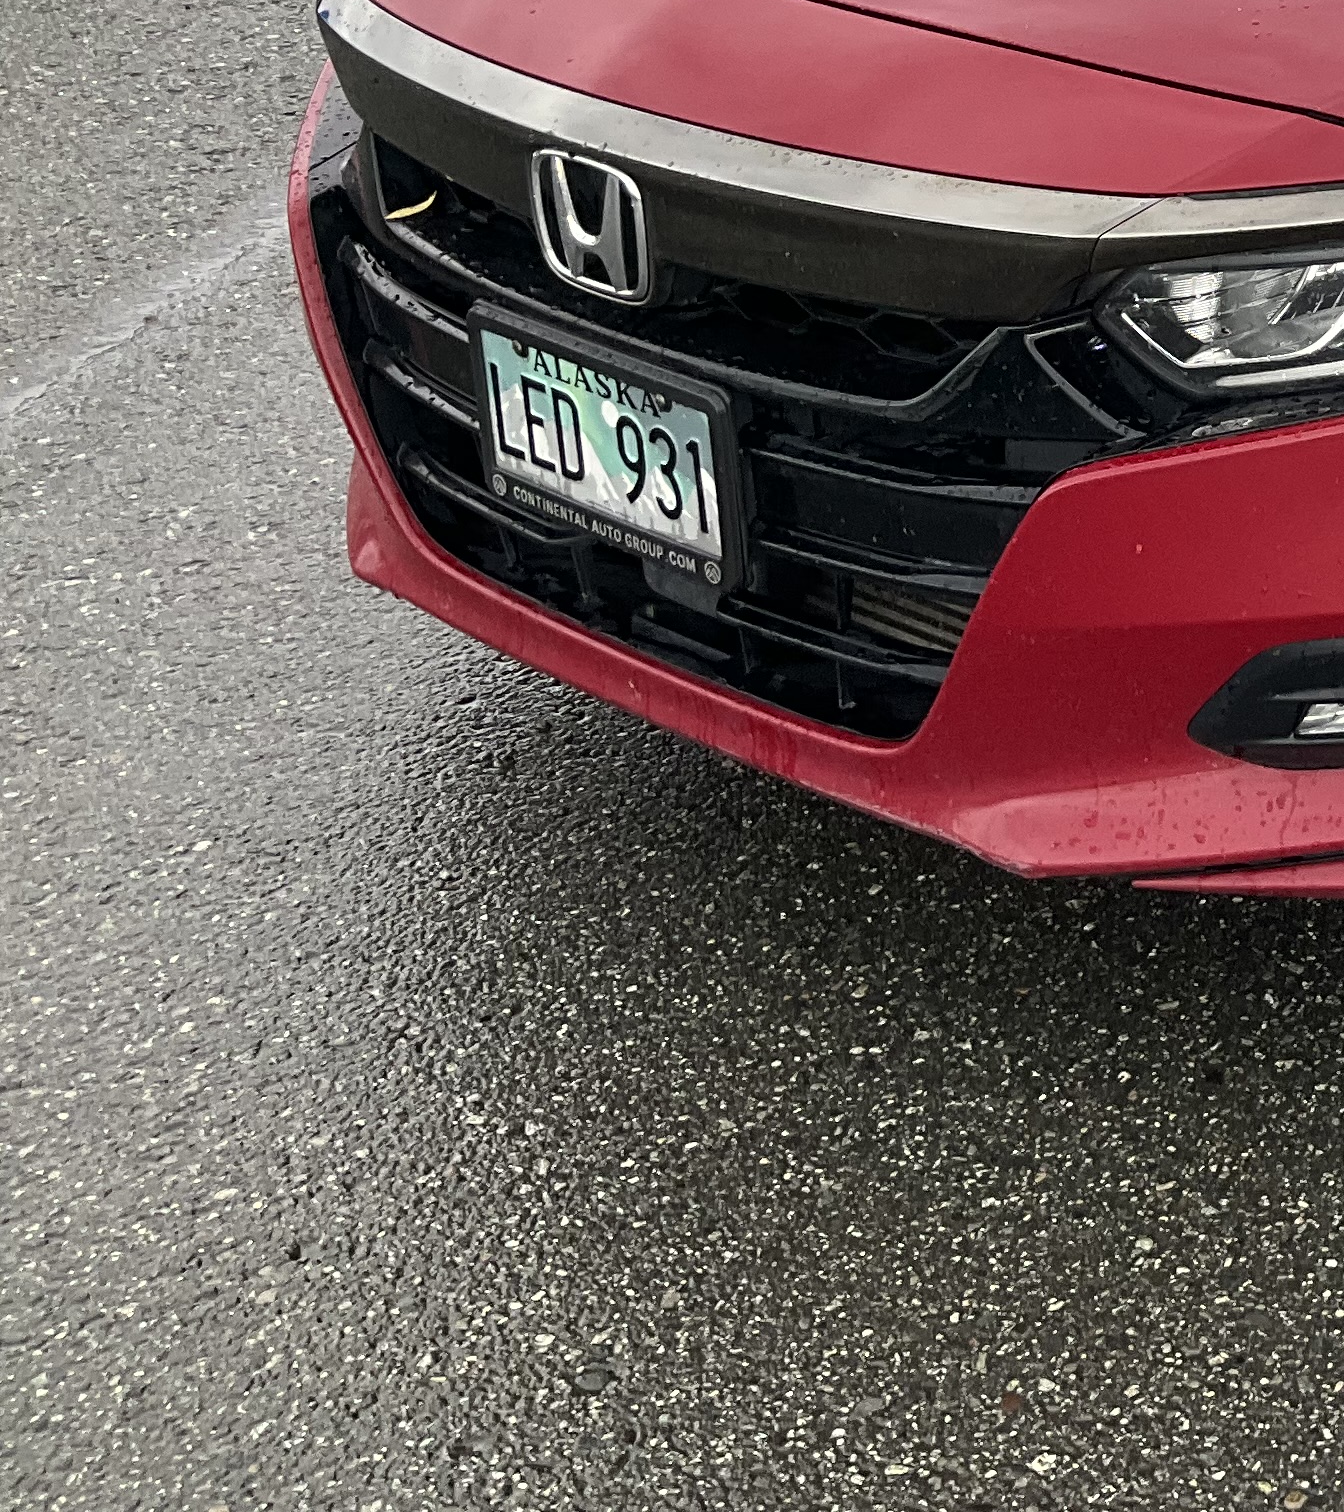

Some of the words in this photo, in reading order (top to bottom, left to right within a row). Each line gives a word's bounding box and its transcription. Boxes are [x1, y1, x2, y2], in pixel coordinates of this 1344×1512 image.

[533, 348, 662, 418] ALASKA
[489, 362, 586, 481] LED
[616, 414, 710, 534] 931
[513, 485, 588, 530] CONTINENTAL
[591, 519, 622, 543] AUTO
[624, 534, 663, 560] GROUP
